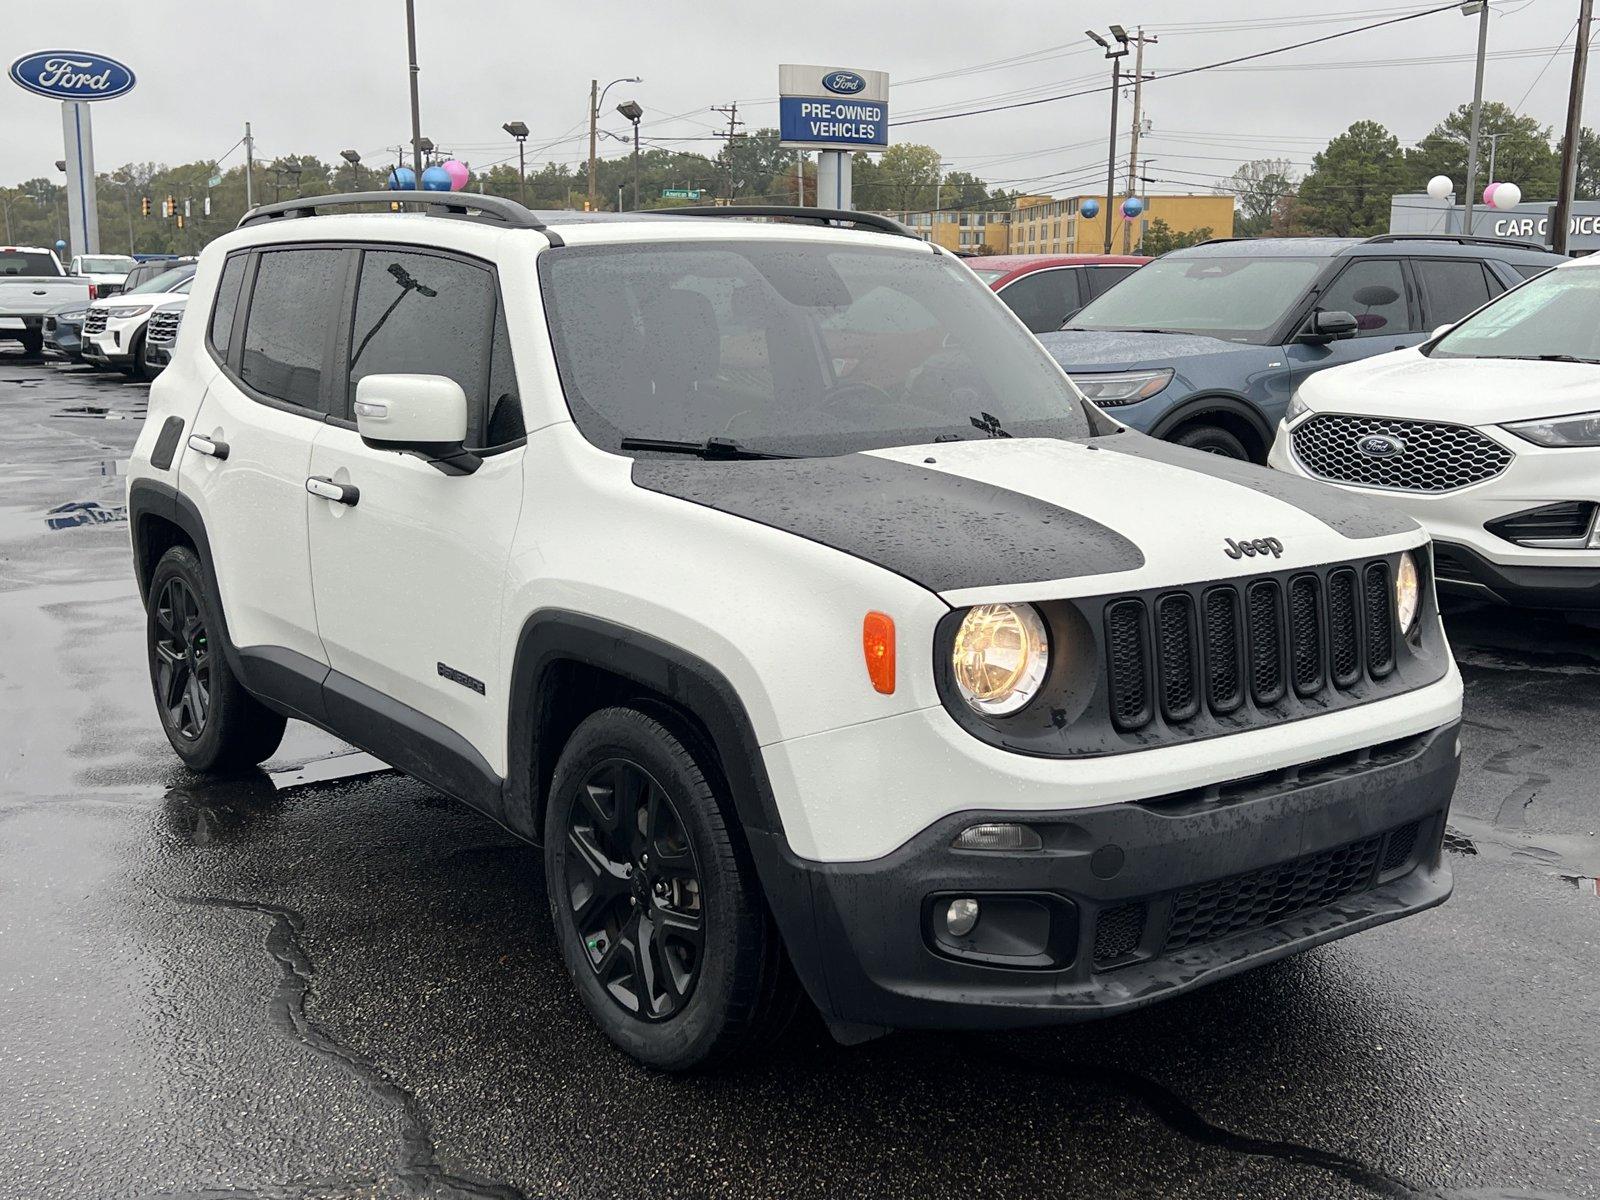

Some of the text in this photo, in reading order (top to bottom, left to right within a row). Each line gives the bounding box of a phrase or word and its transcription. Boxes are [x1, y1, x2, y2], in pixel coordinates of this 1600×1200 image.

[38, 58, 111, 90] Ford
[832, 74, 858, 90] Ford
[801, 102, 881, 122] PRE-OWNED
[810, 121, 875, 139] VEHICLES
[1494, 218, 1534, 237] CAR
[1365, 439, 1389, 452] Ford
[1223, 536, 1284, 560] Jeep
